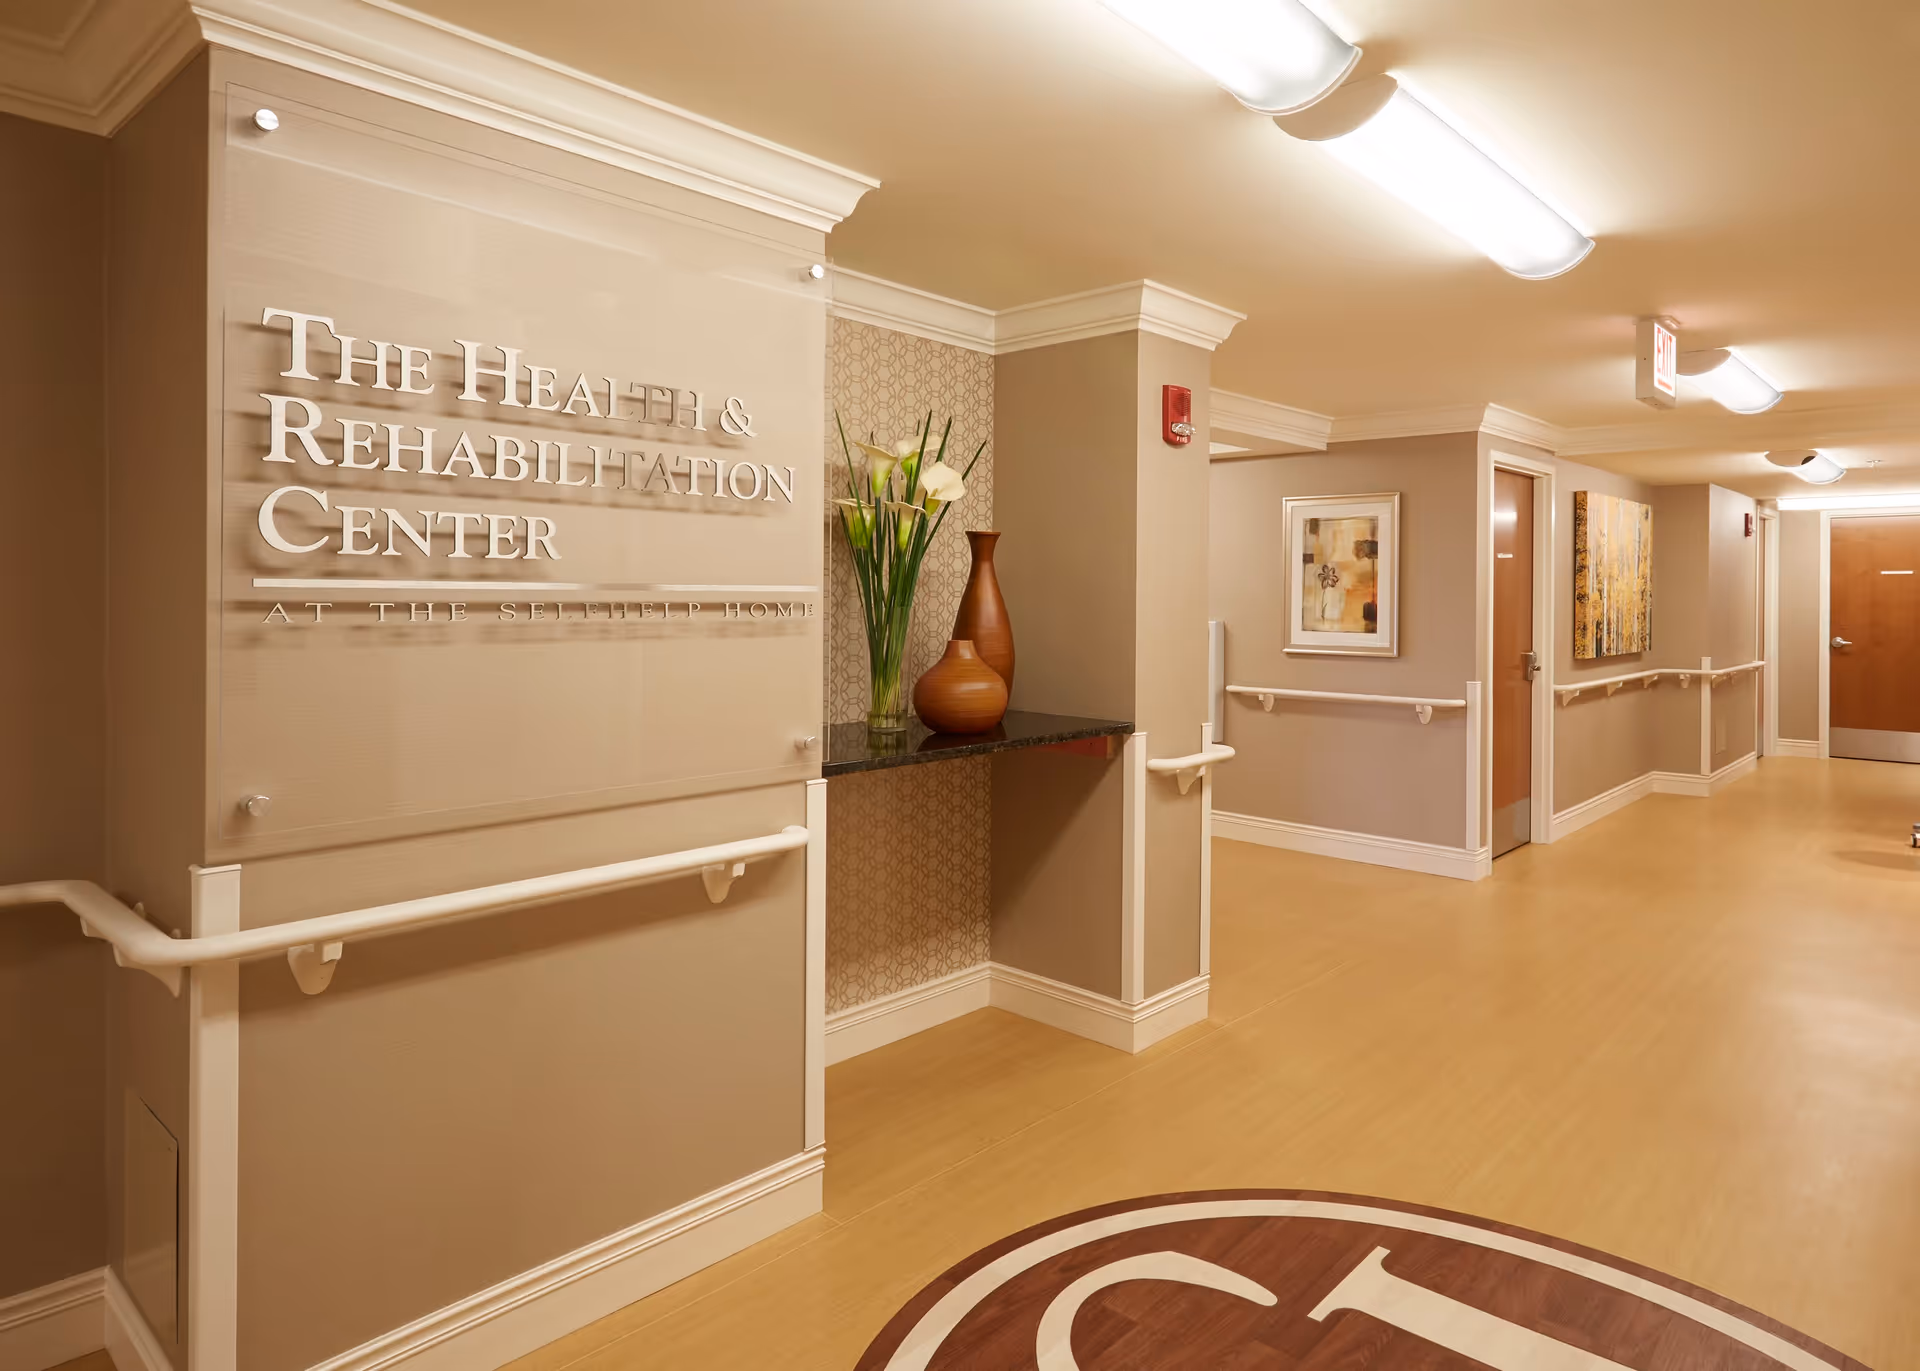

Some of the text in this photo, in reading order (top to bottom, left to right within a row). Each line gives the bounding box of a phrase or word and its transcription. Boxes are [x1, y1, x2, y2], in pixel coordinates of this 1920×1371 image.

[261, 307, 758, 438] THE HEALTH &
[1656, 326, 1673, 378] EXIT
[258, 393, 796, 503] REHABILITATION
[257, 485, 563, 560] CENTER
[261, 602, 816, 623] AT THE SELFHELP HOME
